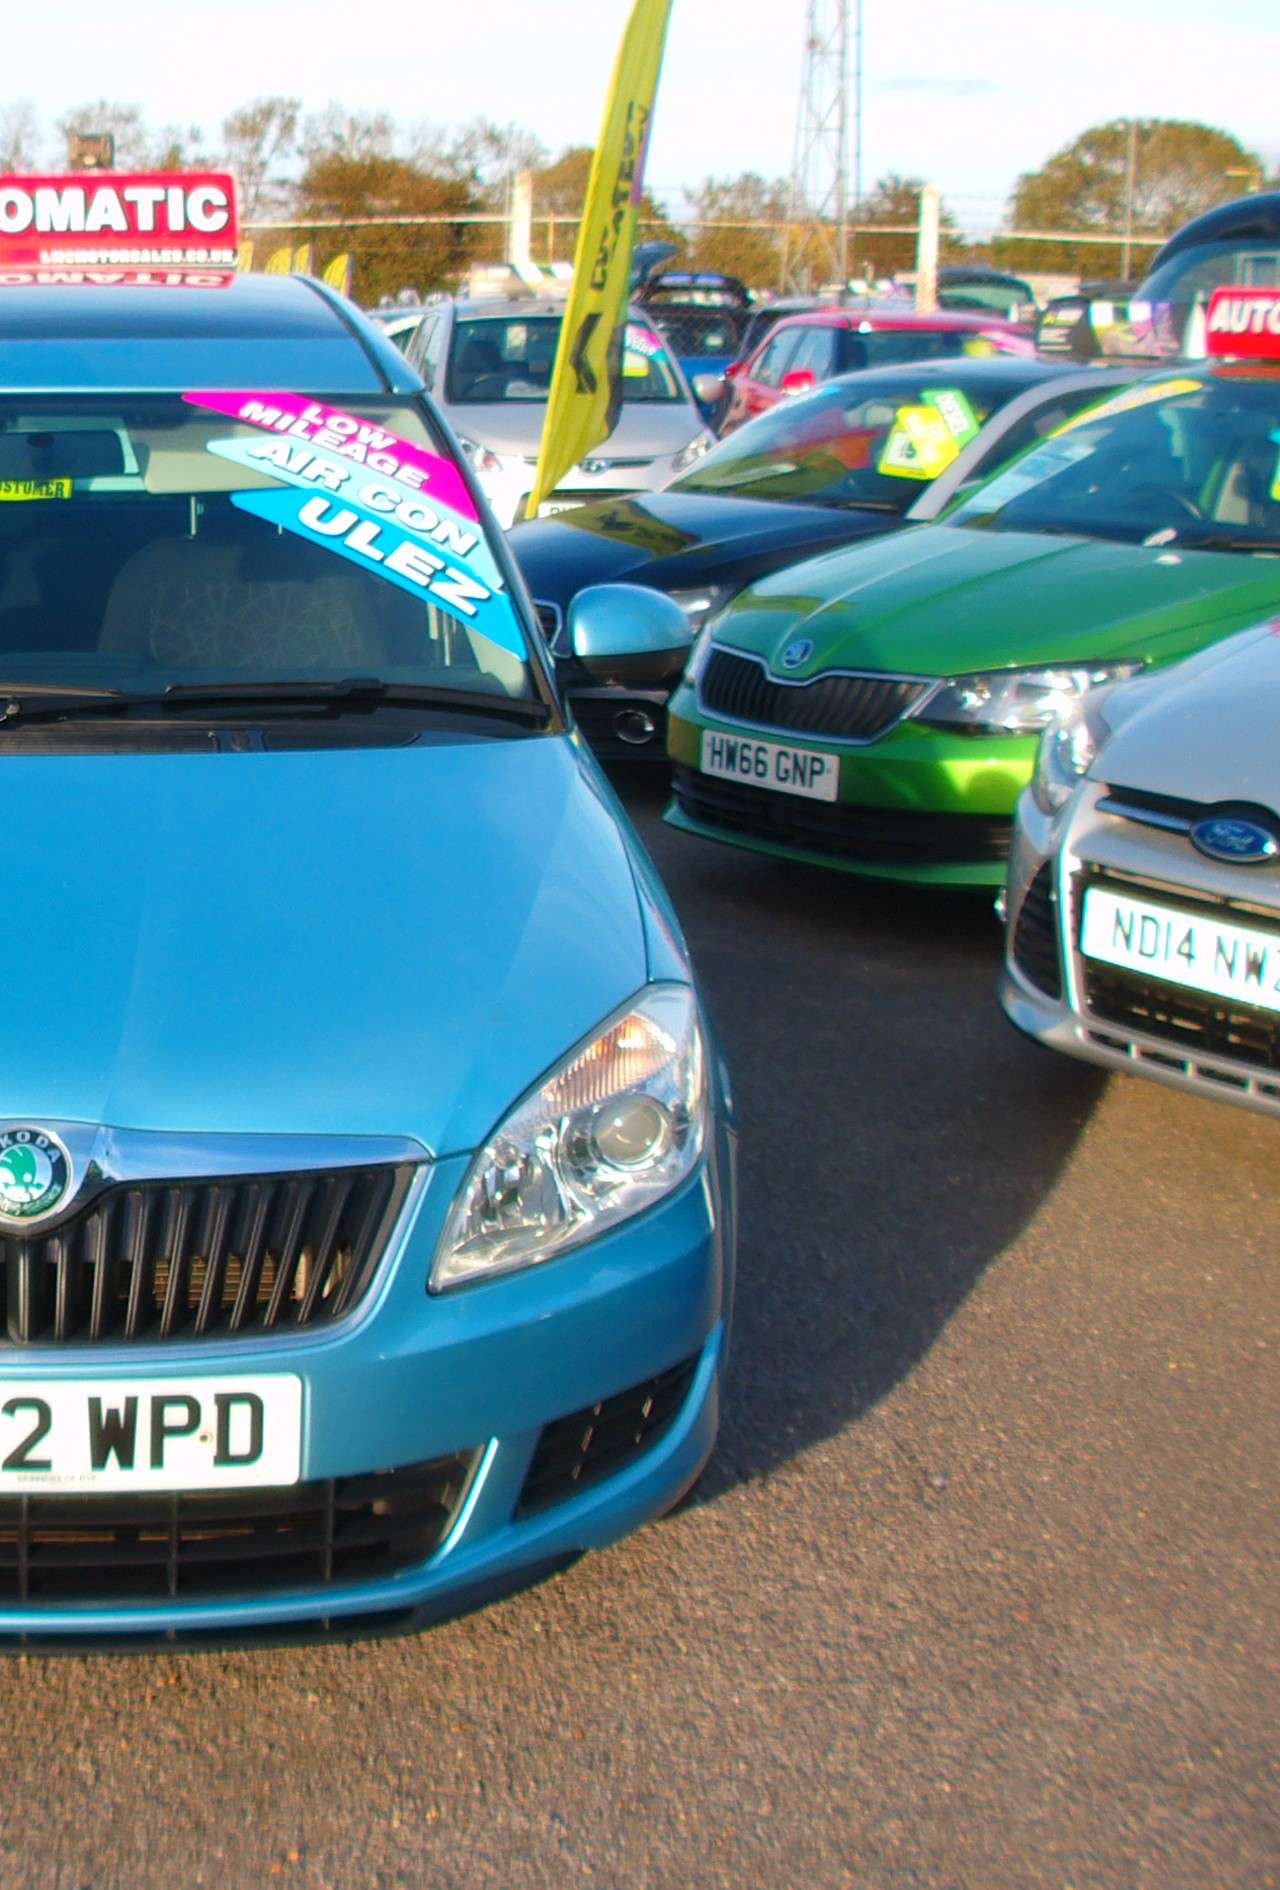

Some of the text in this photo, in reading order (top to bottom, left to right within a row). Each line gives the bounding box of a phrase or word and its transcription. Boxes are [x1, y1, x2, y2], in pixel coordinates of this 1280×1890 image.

[238, 401, 430, 489] MILEAGE
[301, 405, 398, 451] LOW
[247, 440, 480, 558] AIR CON
[298, 496, 492, 618] ULEZ
[710, 736, 825, 788] HW66 GNP
[1113, 907, 1195, 968] ND14
[87, 1392, 264, 1470] WPD
